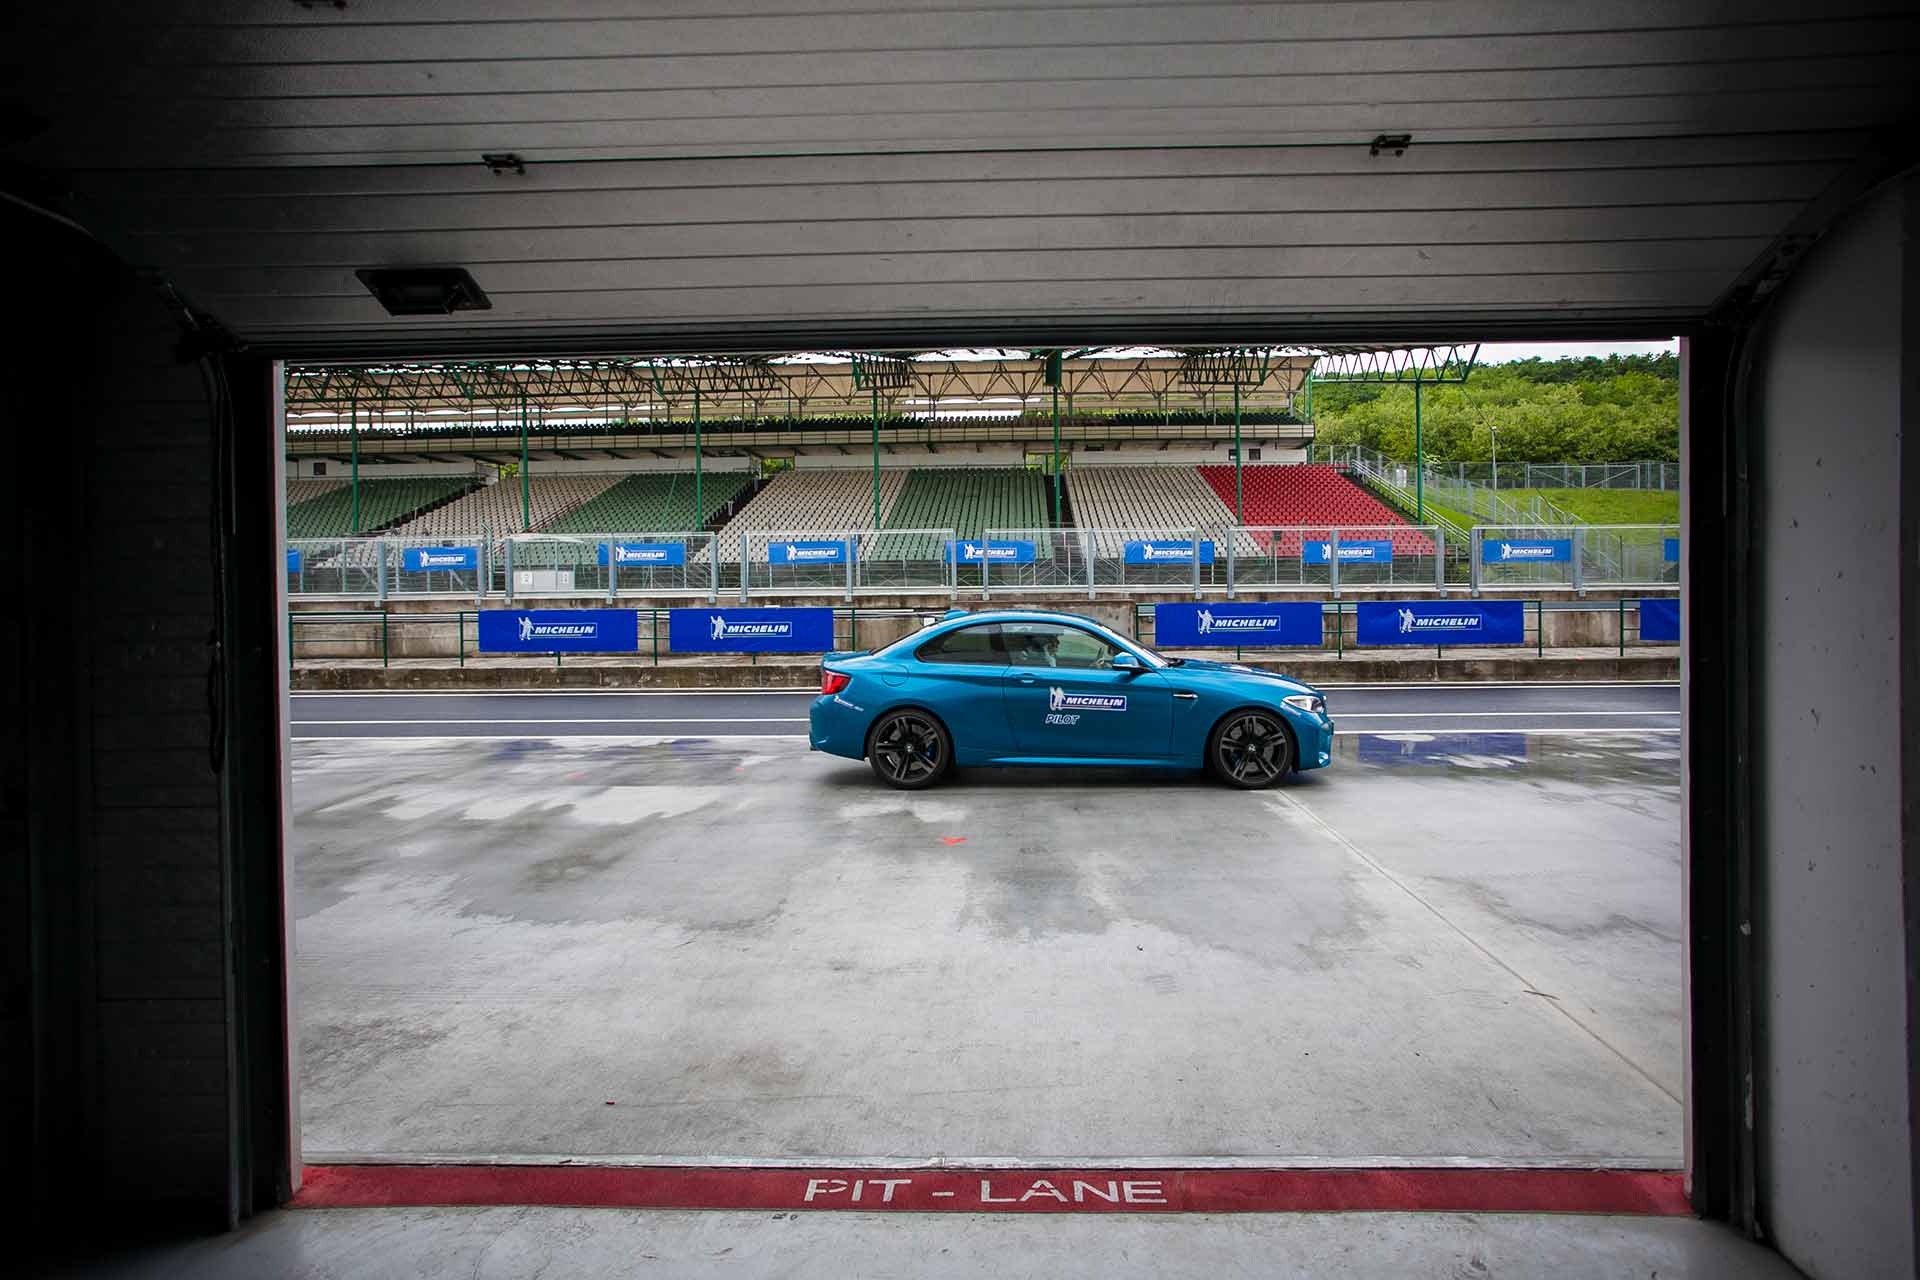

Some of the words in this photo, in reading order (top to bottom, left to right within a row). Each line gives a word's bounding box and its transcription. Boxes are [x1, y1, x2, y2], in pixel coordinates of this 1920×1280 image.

[1215, 619, 1277, 627] MICHELIN
[1416, 618, 1478, 626] MICHELIN
[535, 626, 595, 634] MICHELIN
[727, 625, 789, 633] MICHELIN
[1066, 697, 1123, 706] MICHELIN
[1045, 714, 1080, 724] PILOT
[803, 1179, 912, 1201] PIT
[981, 1179, 1168, 1203] LANE
